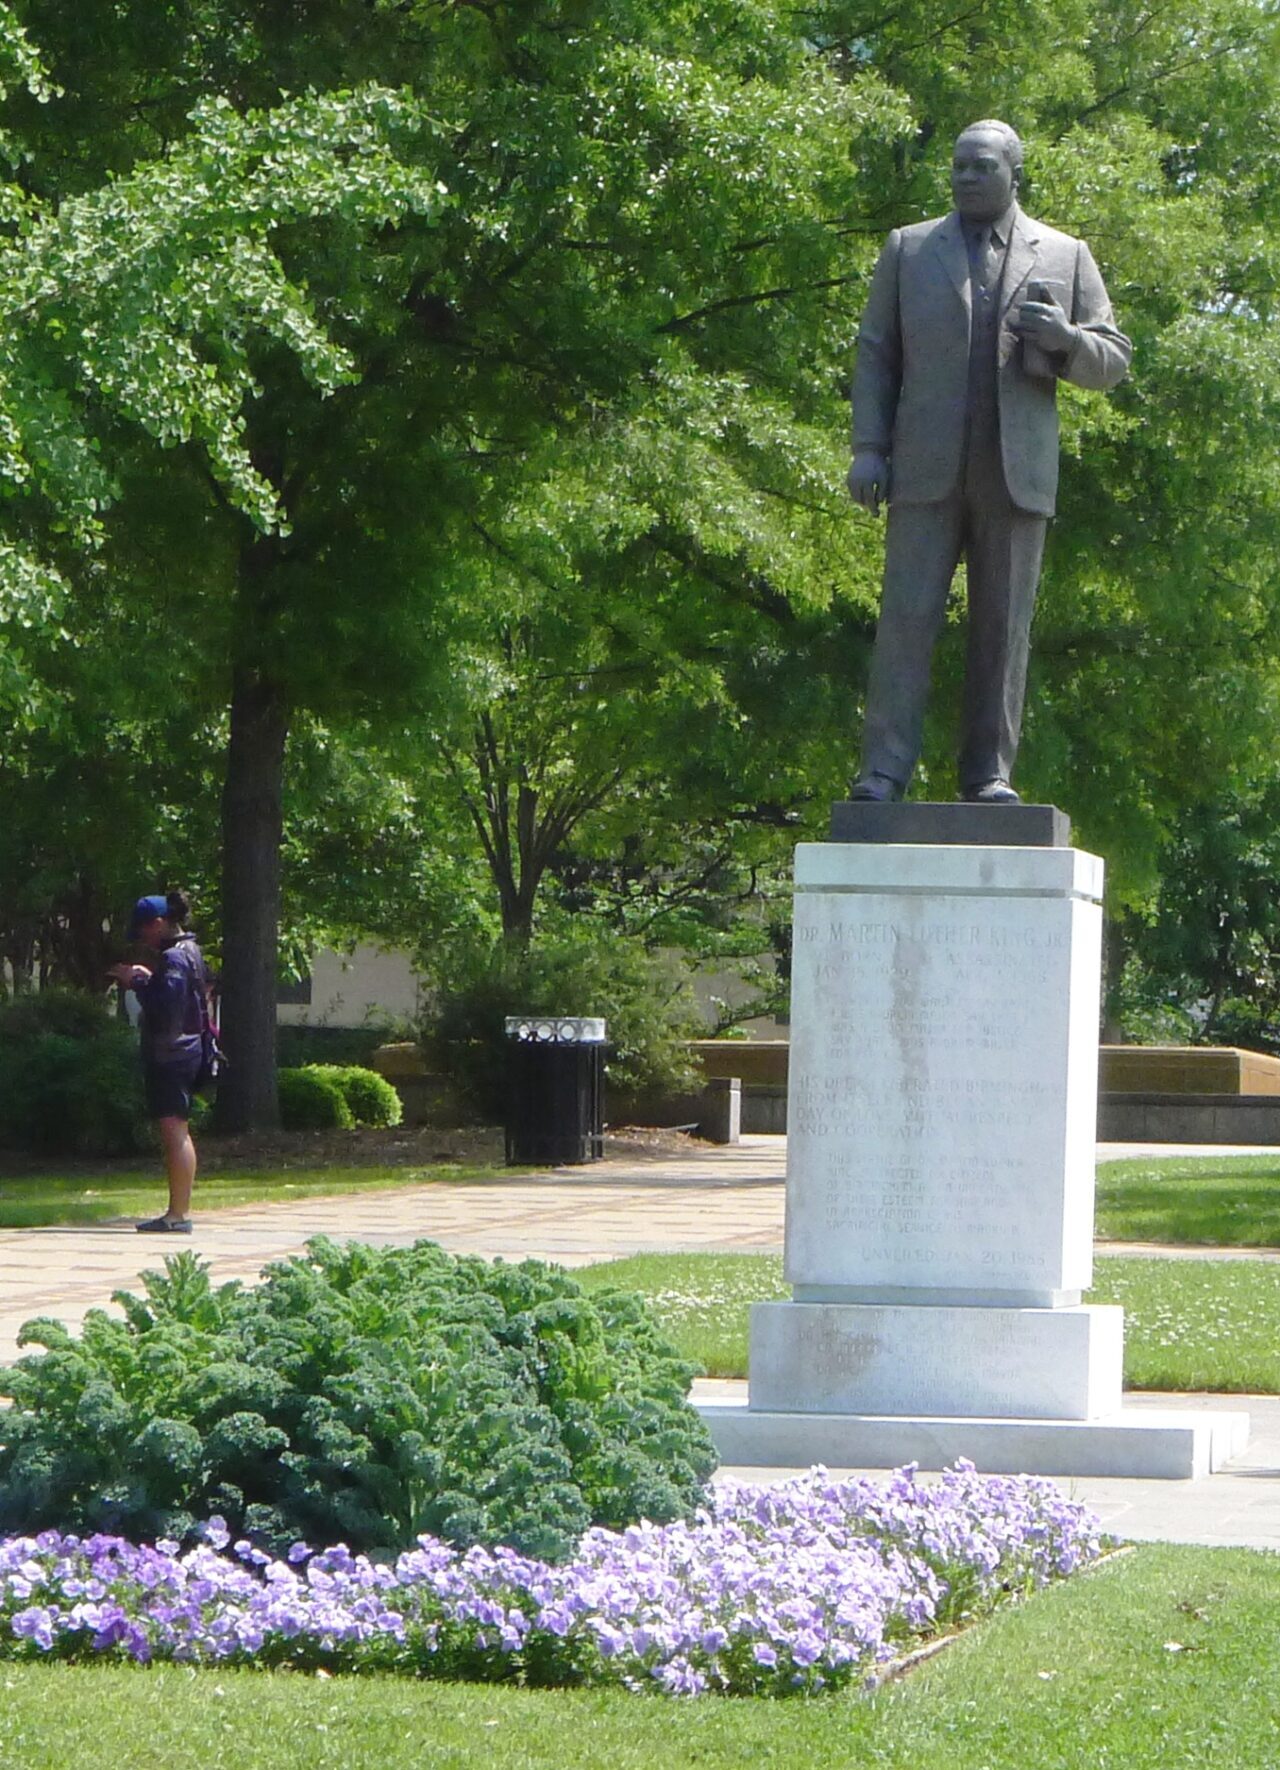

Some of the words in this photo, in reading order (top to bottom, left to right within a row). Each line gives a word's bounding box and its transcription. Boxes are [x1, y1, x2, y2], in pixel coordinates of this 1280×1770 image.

[828, 922, 901, 944] MARTIN
[910, 925, 981, 945] LUTHER
[988, 926, 1036, 948] KING
[797, 1107, 824, 1121] DAY
[797, 1123, 829, 1137] AND
